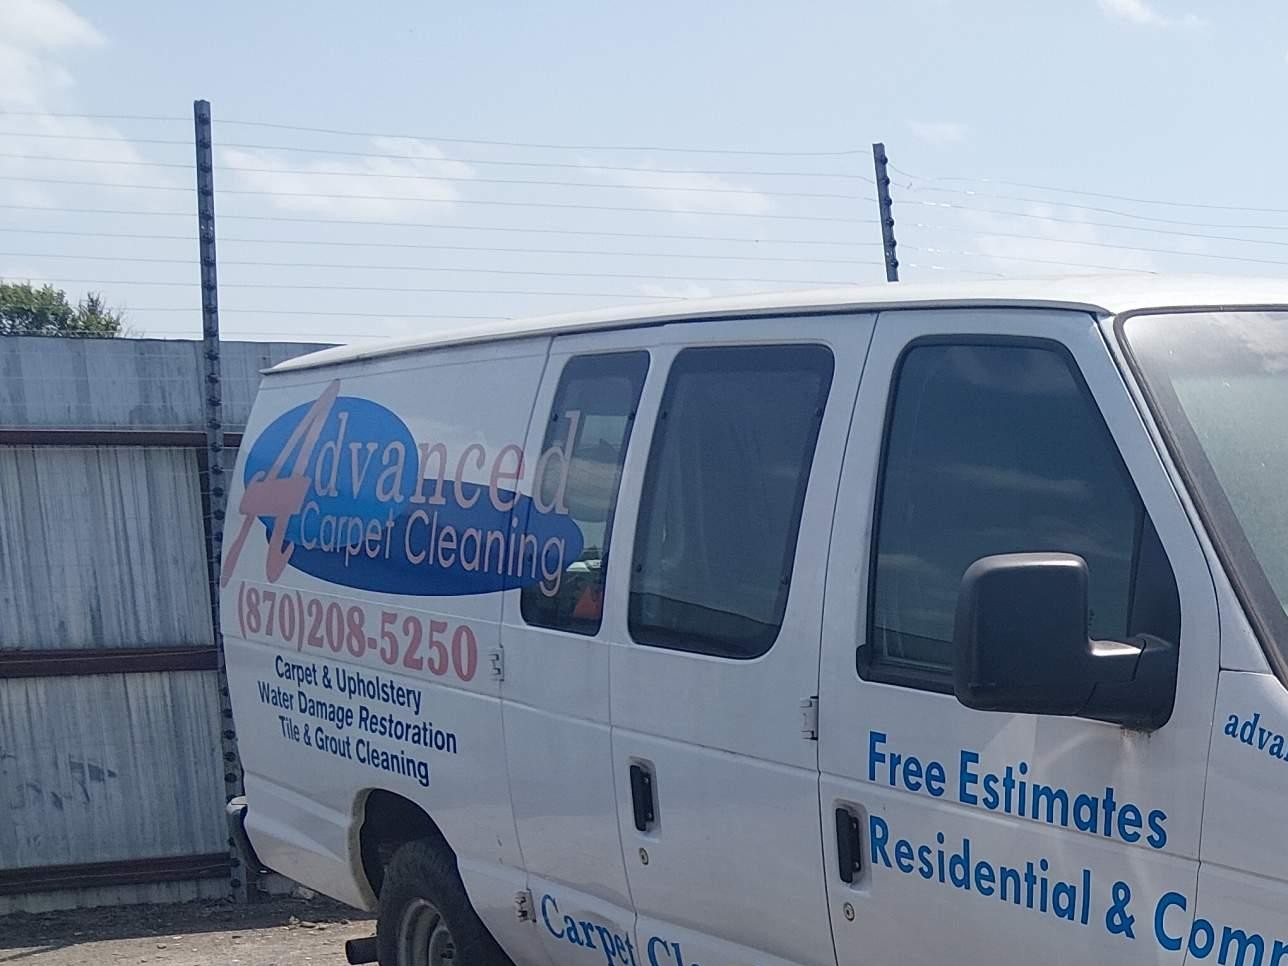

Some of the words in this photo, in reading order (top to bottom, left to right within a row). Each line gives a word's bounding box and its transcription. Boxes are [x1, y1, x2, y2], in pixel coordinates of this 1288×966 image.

[221, 378, 581, 588] Advanced
[300, 502, 395, 566] Carpet
[405, 509, 566, 597] Cleaning
[238, 581, 478, 682] (870)208-5250
[257, 680, 294, 711] Water
[297, 690, 354, 730] Damage
[358, 705, 457, 754] Restoration
[275, 655, 318, 687] Carpet
[322, 665, 333, 689] &
[335, 667, 422, 715] Upholstery
[278, 715, 300, 742] Tile
[303, 723, 312, 747] &
[314, 726, 352, 760] Grout
[355, 738, 430, 787] Cleaning
[867, 731, 947, 798] Free
[959, 750, 1168, 850] Estimates
[869, 815, 1092, 926] Residential
[1105, 881, 1137, 940] &
